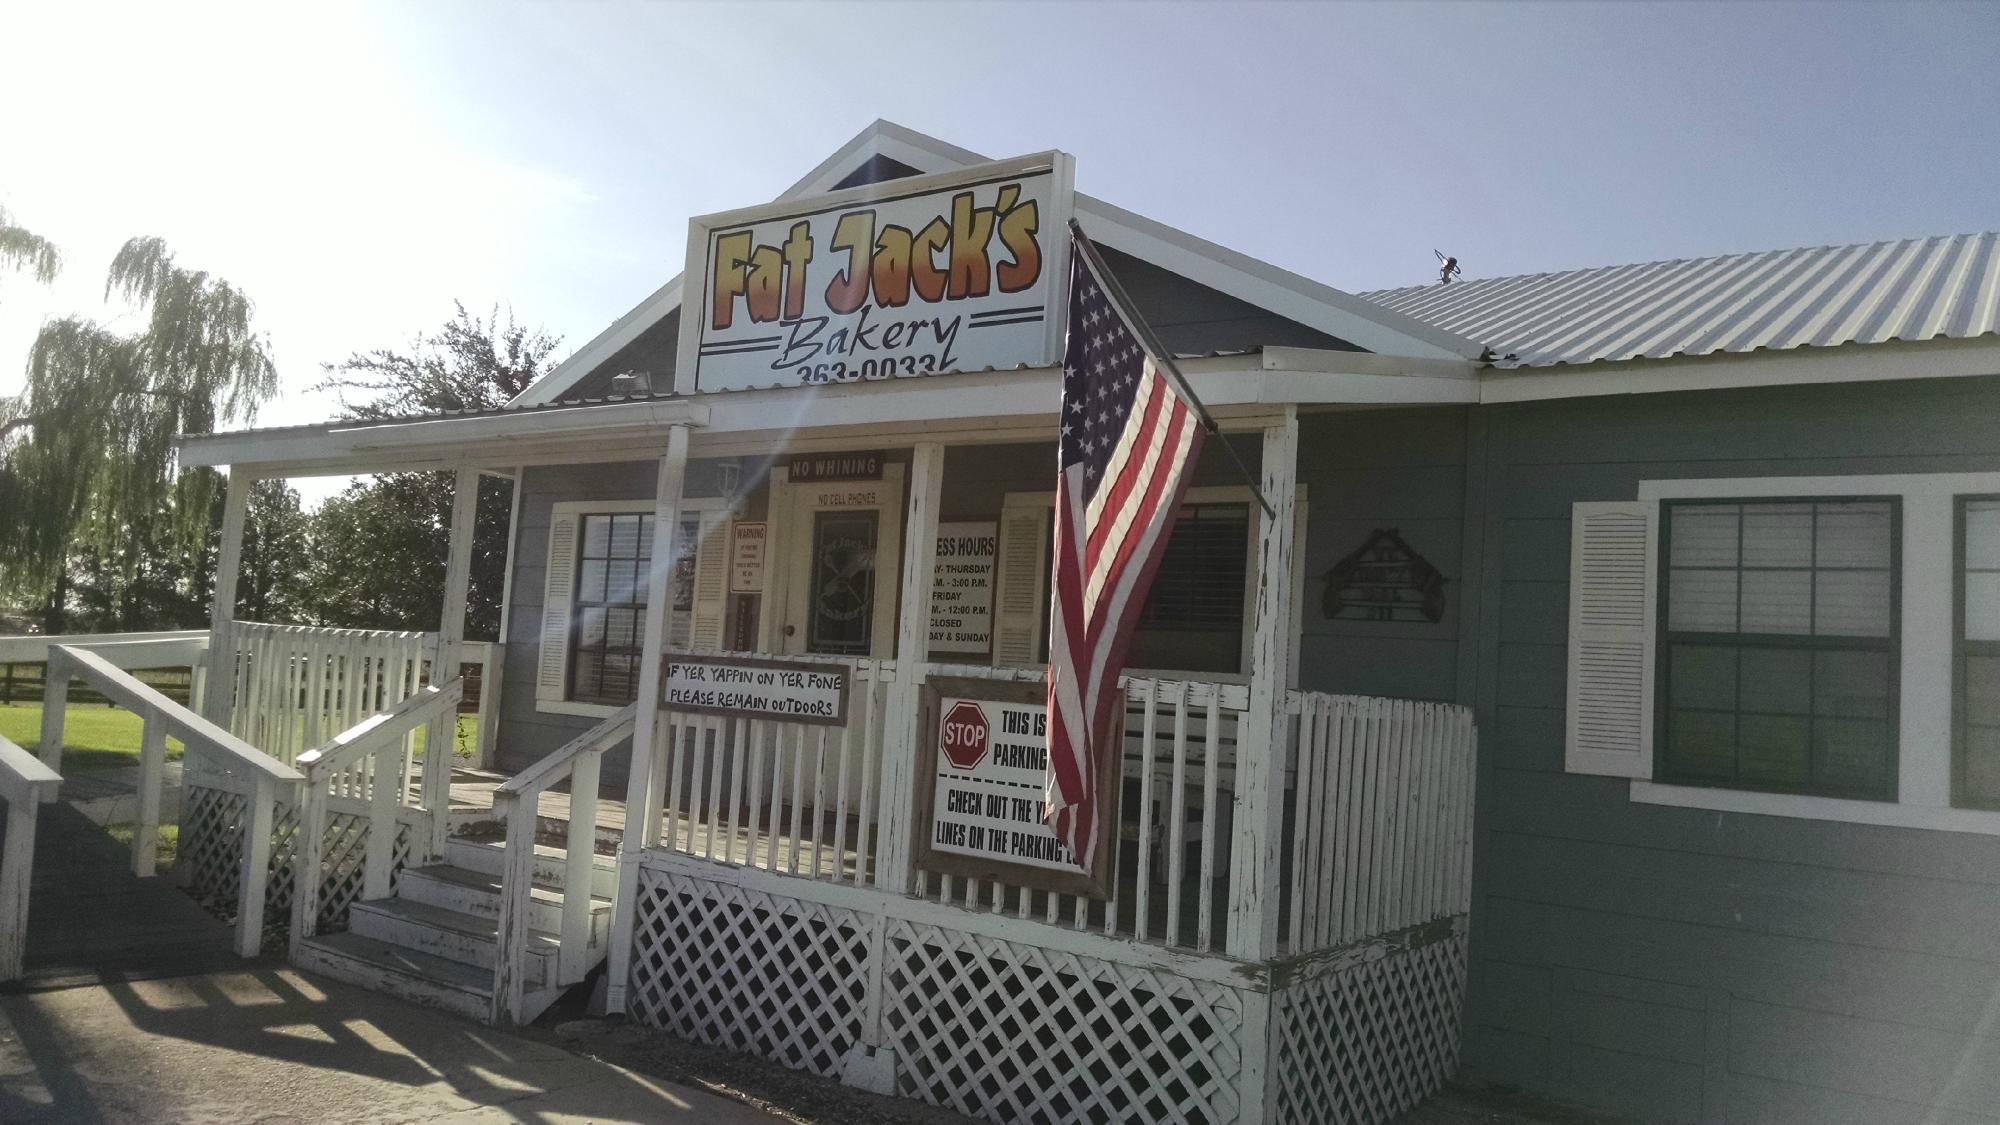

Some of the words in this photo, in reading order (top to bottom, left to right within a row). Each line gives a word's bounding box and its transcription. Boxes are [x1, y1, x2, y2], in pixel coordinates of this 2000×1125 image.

[711, 220, 813, 330] Fat
[825, 183, 1042, 314] Jack's
[771, 304, 961, 371] Bakery
[792, 461, 809, 477] NO
[815, 458, 876, 476] WHINING
[830, 494, 846, 505] CELL
[737, 527, 764, 539] WARNING
[936, 538, 956, 557] ESS
[958, 536, 995, 557] HOURS
[946, 564, 991, 574] THURSDAY
[952, 578, 969, 588] 3:00
[971, 578, 988, 588] P.M.
[932, 591, 962, 601] FRIDAY
[948, 605, 970, 615] 12:00
[972, 606, 989, 615] P.M.
[930, 618, 962, 628] CLOSED
[946, 632, 952, 641] &
[955, 632, 990, 643] SUNDAY
[682, 666, 706, 682] YER
[710, 667, 754, 685] YAPPIN
[757, 672, 775, 687] ON
[779, 672, 804, 689] YER
[807, 673, 842, 690] FONE
[670, 689, 714, 705] PLEASE
[717, 692, 769, 710] REMAIN
[771, 698, 833, 716] OUTDOORS
[1002, 710, 1030, 736] THIS
[1033, 713, 1046, 737] IS
[944, 721, 986, 748] STOP
[993, 743, 1047, 771] PARKING
[947, 789, 983, 816] CHECK
[986, 793, 1008, 819] OUT
[1011, 797, 1032, 823] THE
[935, 821, 966, 848] LINES
[968, 825, 985, 851] ON
[988, 828, 1008, 854] THE
[1011, 831, 1063, 863] PARKING
